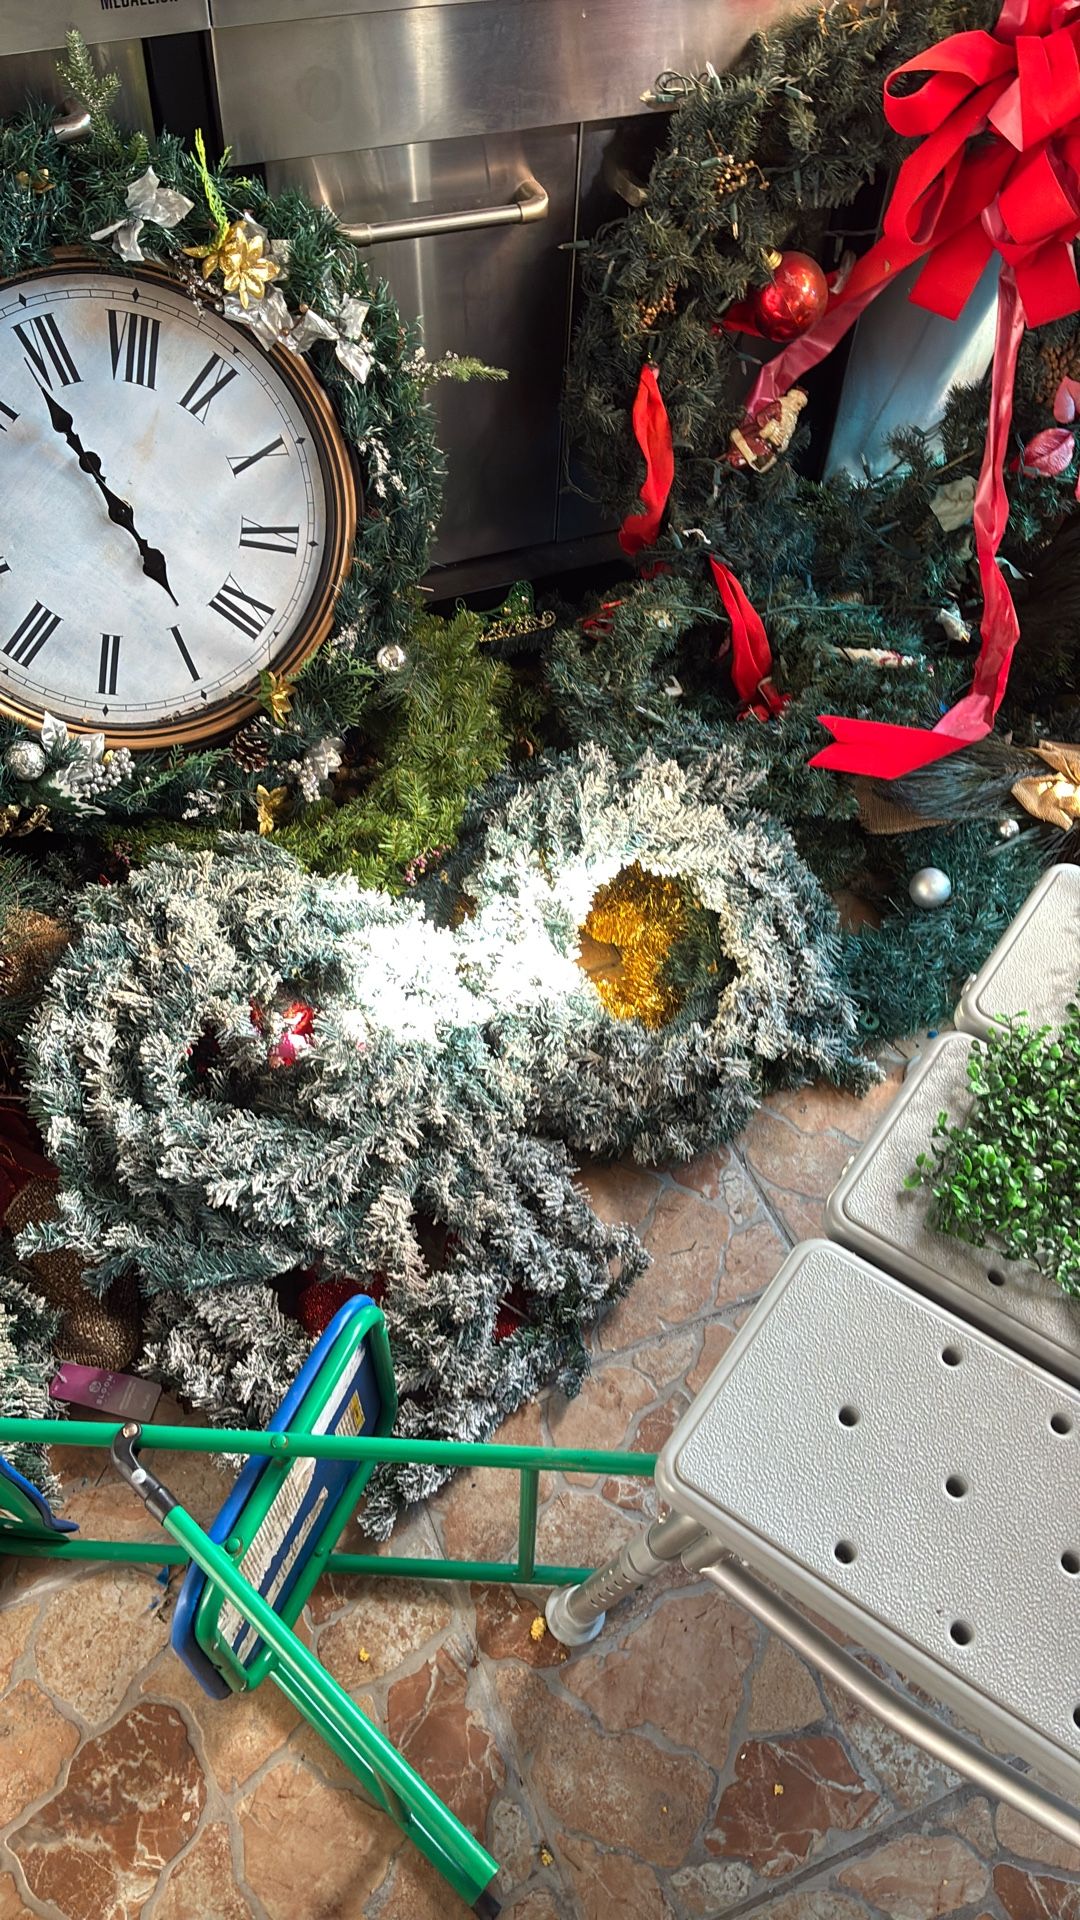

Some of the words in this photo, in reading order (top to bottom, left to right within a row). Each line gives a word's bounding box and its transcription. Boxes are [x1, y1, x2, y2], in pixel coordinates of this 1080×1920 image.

[101, 0, 179, 10] MEDALL
[12, 312, 84, 391] VII
[106, 309, 162, 390] VIII
[177, 352, 241, 425] IX
[226, 435, 289, 478] X
[239, 515, 300, 556] XI
[1, 600, 64, 669] III
[208, 573, 276, 640] XII
[96, 632, 123, 695] II
[95, 1374, 114, 1405] BLOOM
